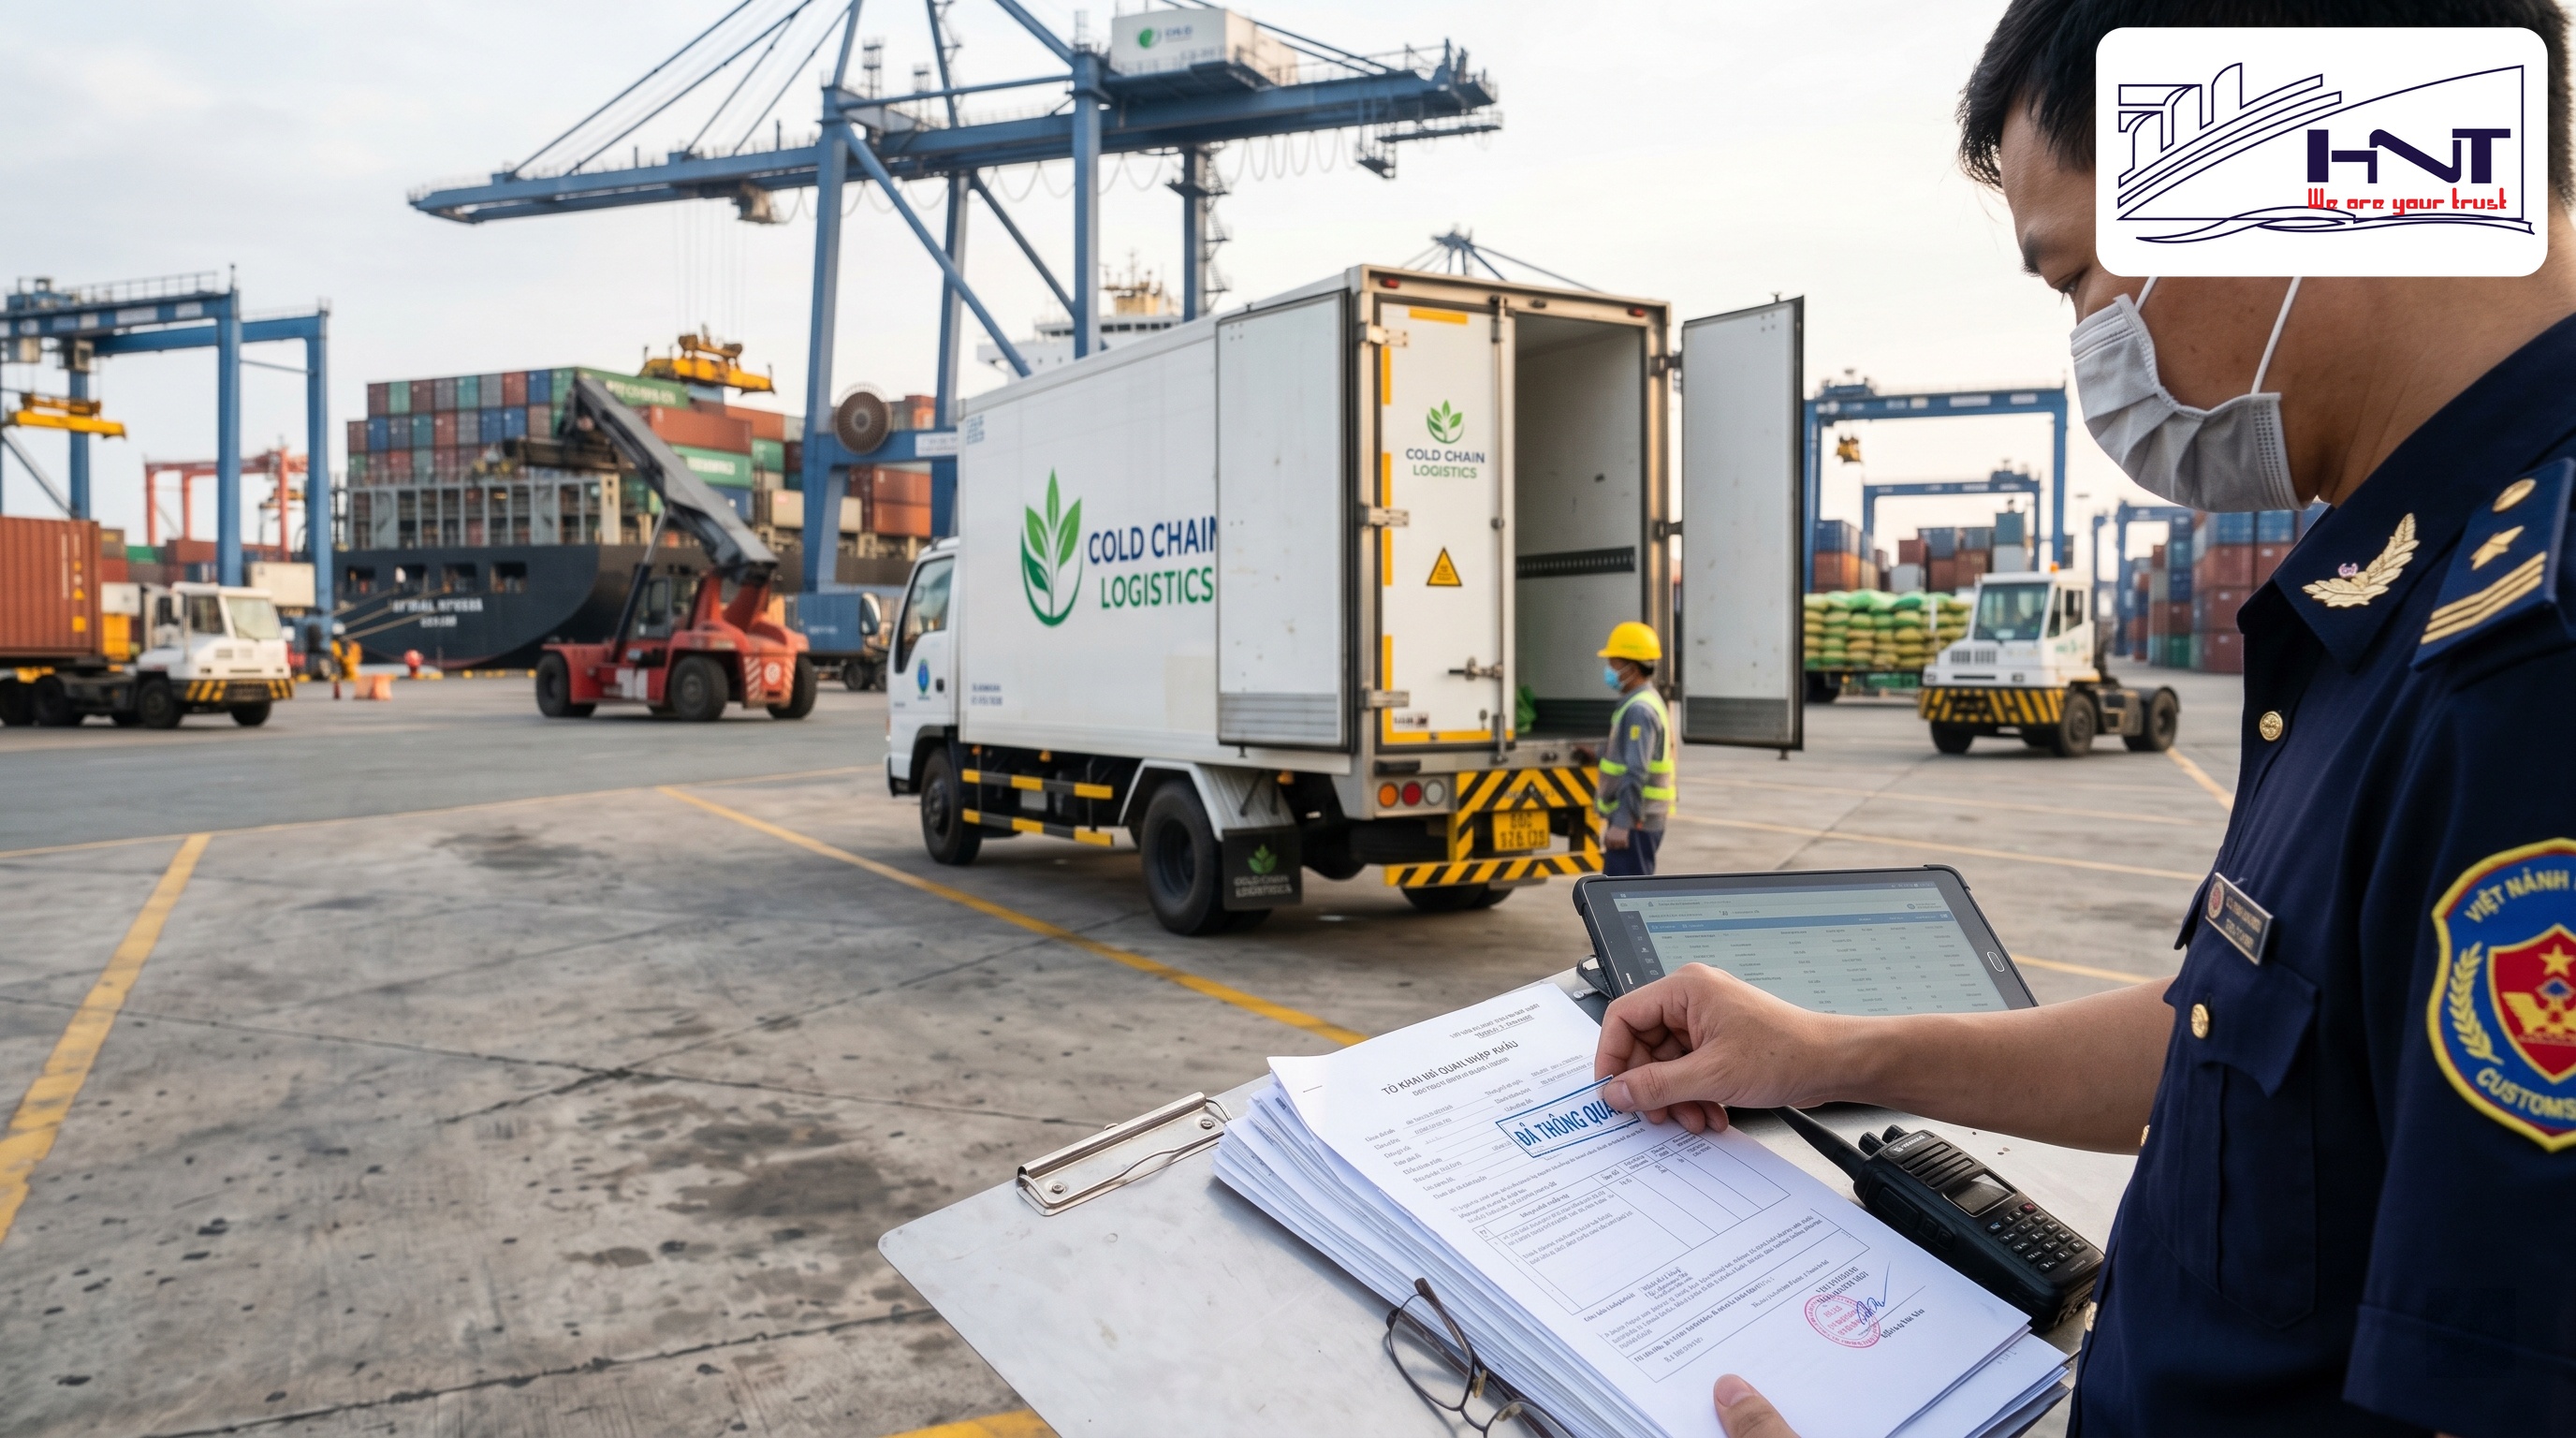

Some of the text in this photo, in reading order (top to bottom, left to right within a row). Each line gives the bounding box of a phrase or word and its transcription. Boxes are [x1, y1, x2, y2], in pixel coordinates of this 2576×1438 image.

[1405, 448, 1486, 464] COLD CHAIN
[1412, 464, 1478, 479] LOGISTICS
[1089, 526, 1145, 565] COLD
[1101, 565, 1214, 609] LOGISTICS
[2476, 1067, 2576, 1121] CUSTOMS
[1533, 1113, 1589, 1139] THÔNG
[1582, 1098, 1623, 1126] QUA
